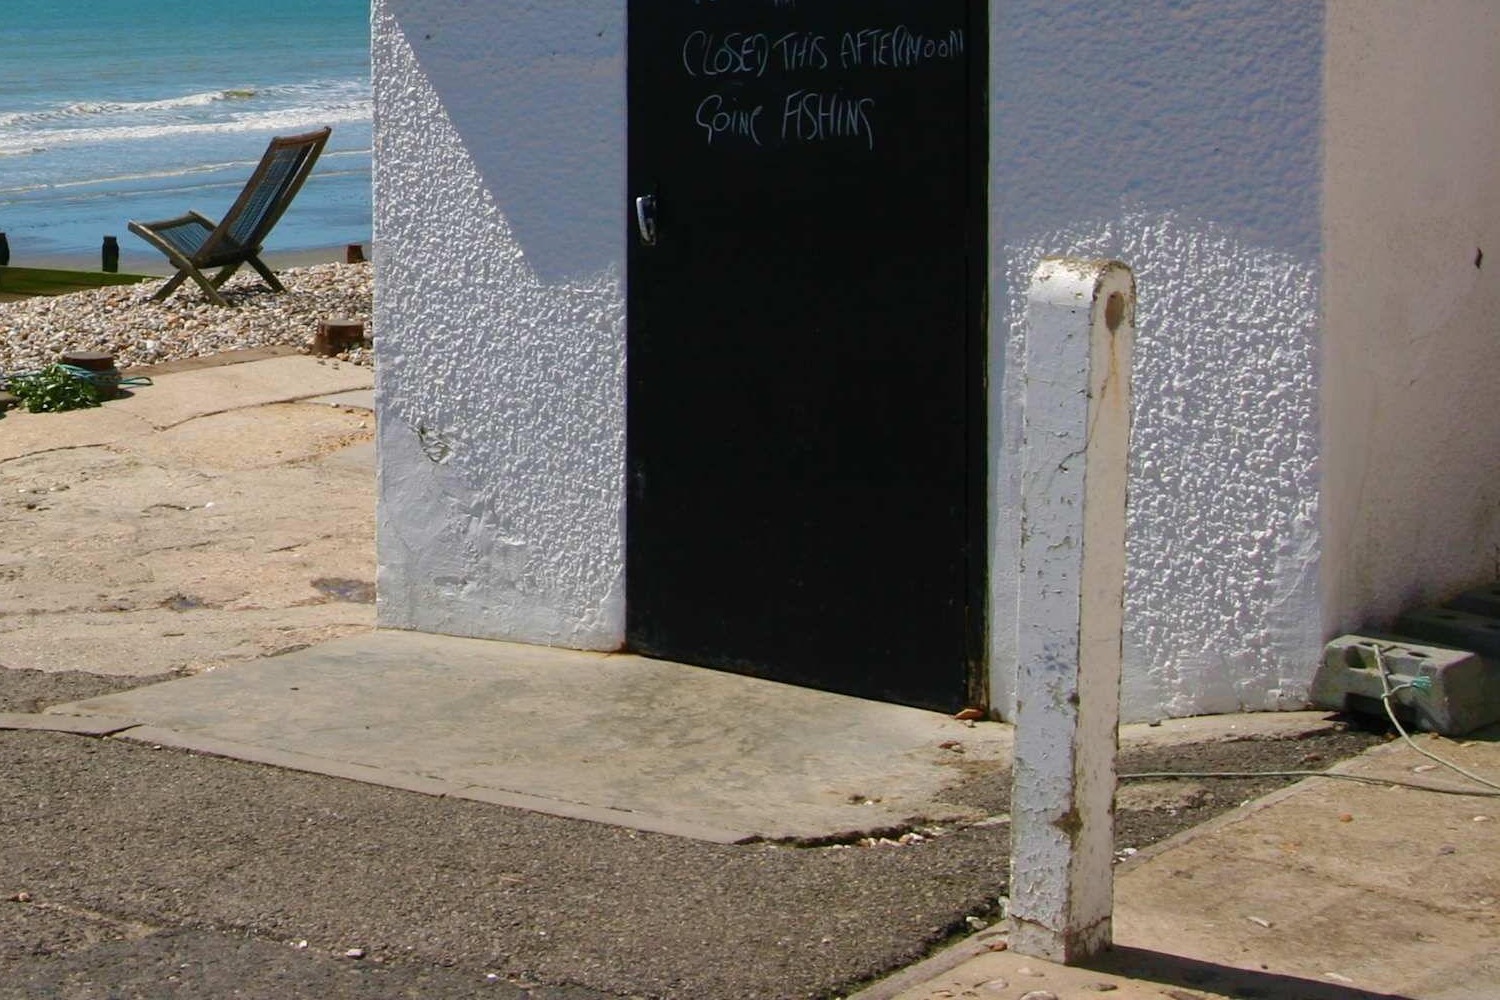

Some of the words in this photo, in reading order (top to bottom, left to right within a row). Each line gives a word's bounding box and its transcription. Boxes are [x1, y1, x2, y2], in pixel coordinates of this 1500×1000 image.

[682, 29, 770, 78] CLOSED
[771, 31, 829, 71] THIS
[695, 93, 764, 146] GOING
[781, 88, 876, 151] FISHING
